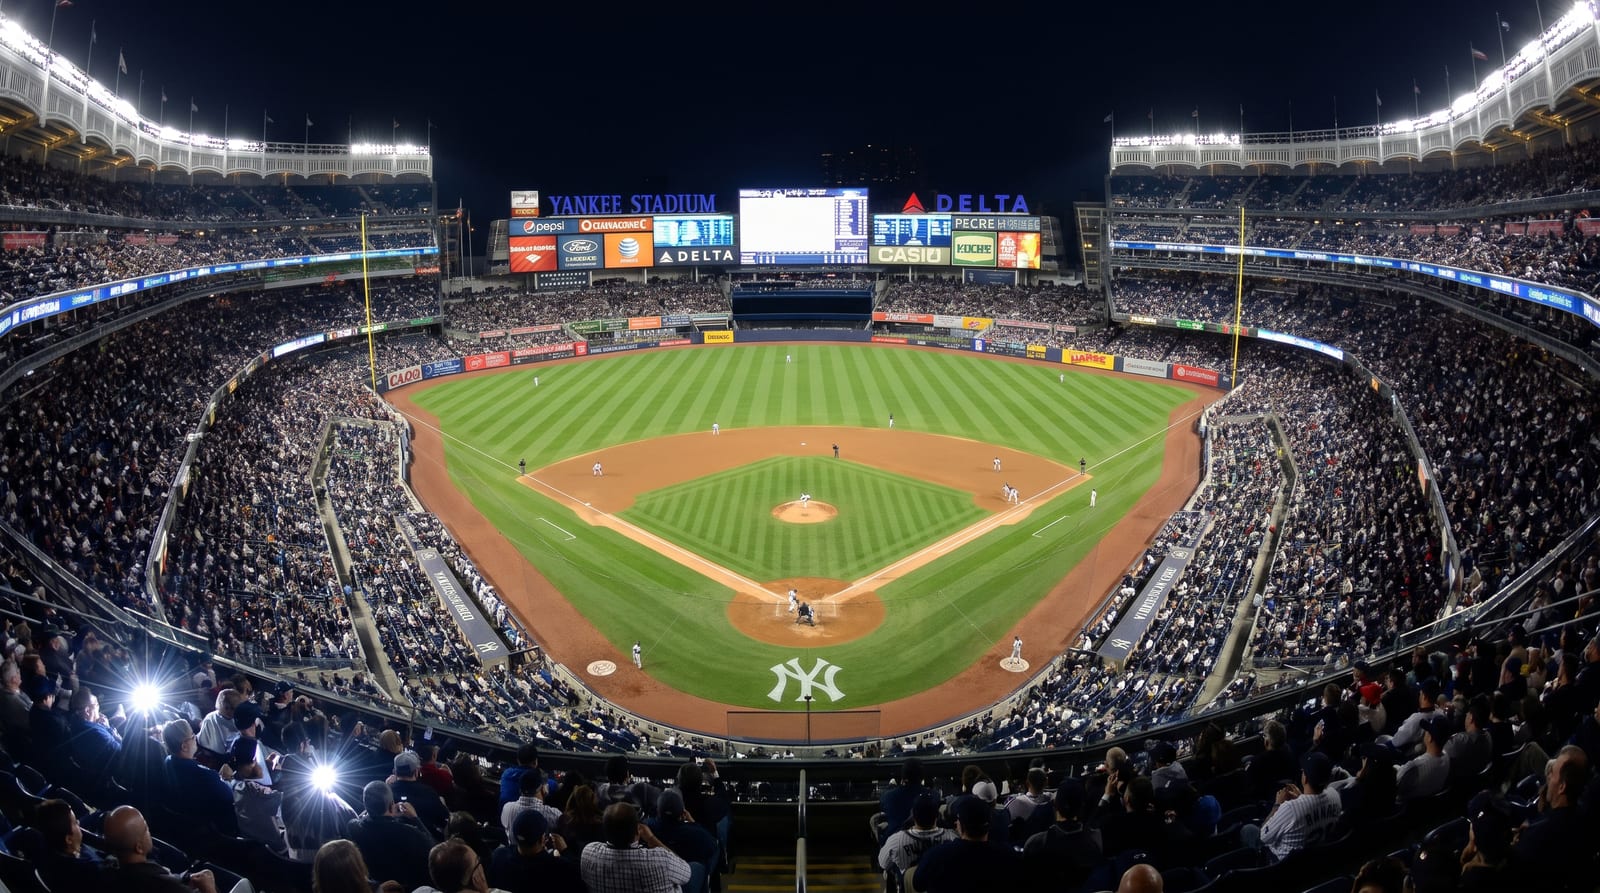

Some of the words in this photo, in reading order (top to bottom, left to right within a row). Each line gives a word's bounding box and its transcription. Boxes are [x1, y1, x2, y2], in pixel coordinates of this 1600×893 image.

[548, 194, 622, 215] YANKEE
[631, 193, 717, 214] STADIUM
[936, 193, 1029, 213] DELTA
[536, 220, 565, 232] pepsi
[568, 241, 591, 253] Ford
[678, 250, 733, 262] DELTA
[766, 657, 846, 702] NY
